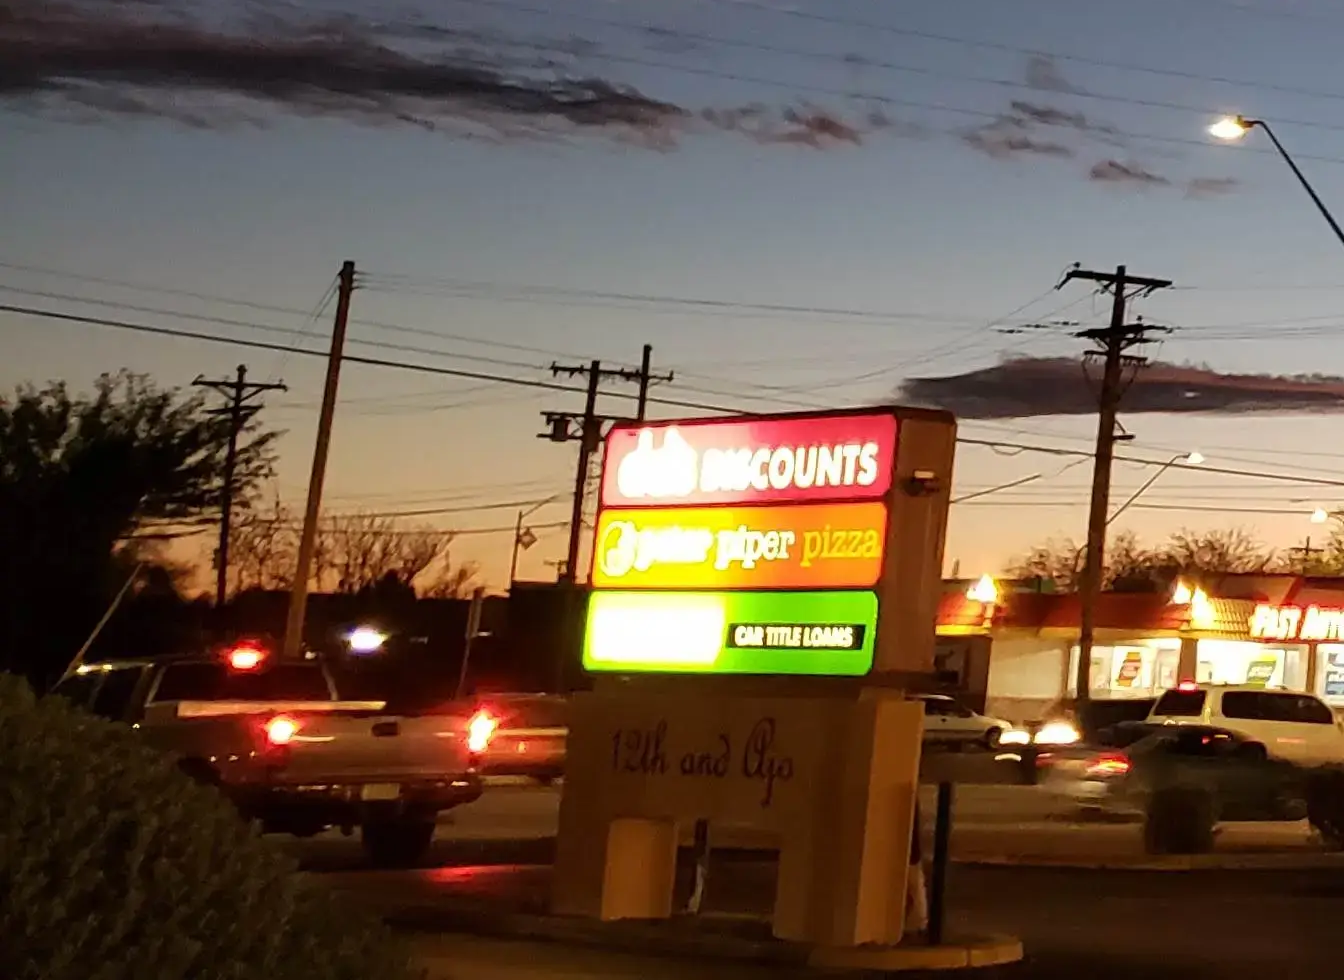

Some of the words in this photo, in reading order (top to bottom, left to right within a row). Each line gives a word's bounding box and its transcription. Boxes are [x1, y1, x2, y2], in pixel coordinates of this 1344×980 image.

[700, 442, 880, 493] DISCOUNTS
[714, 525, 796, 570] piper
[801, 524, 881, 568] pizza
[735, 625, 764, 646] CAR
[765, 626, 802, 647] TITLE
[803, 626, 853, 648] LOANS
[1249, 603, 1301, 639] FAST
[679, 733, 732, 778] and
